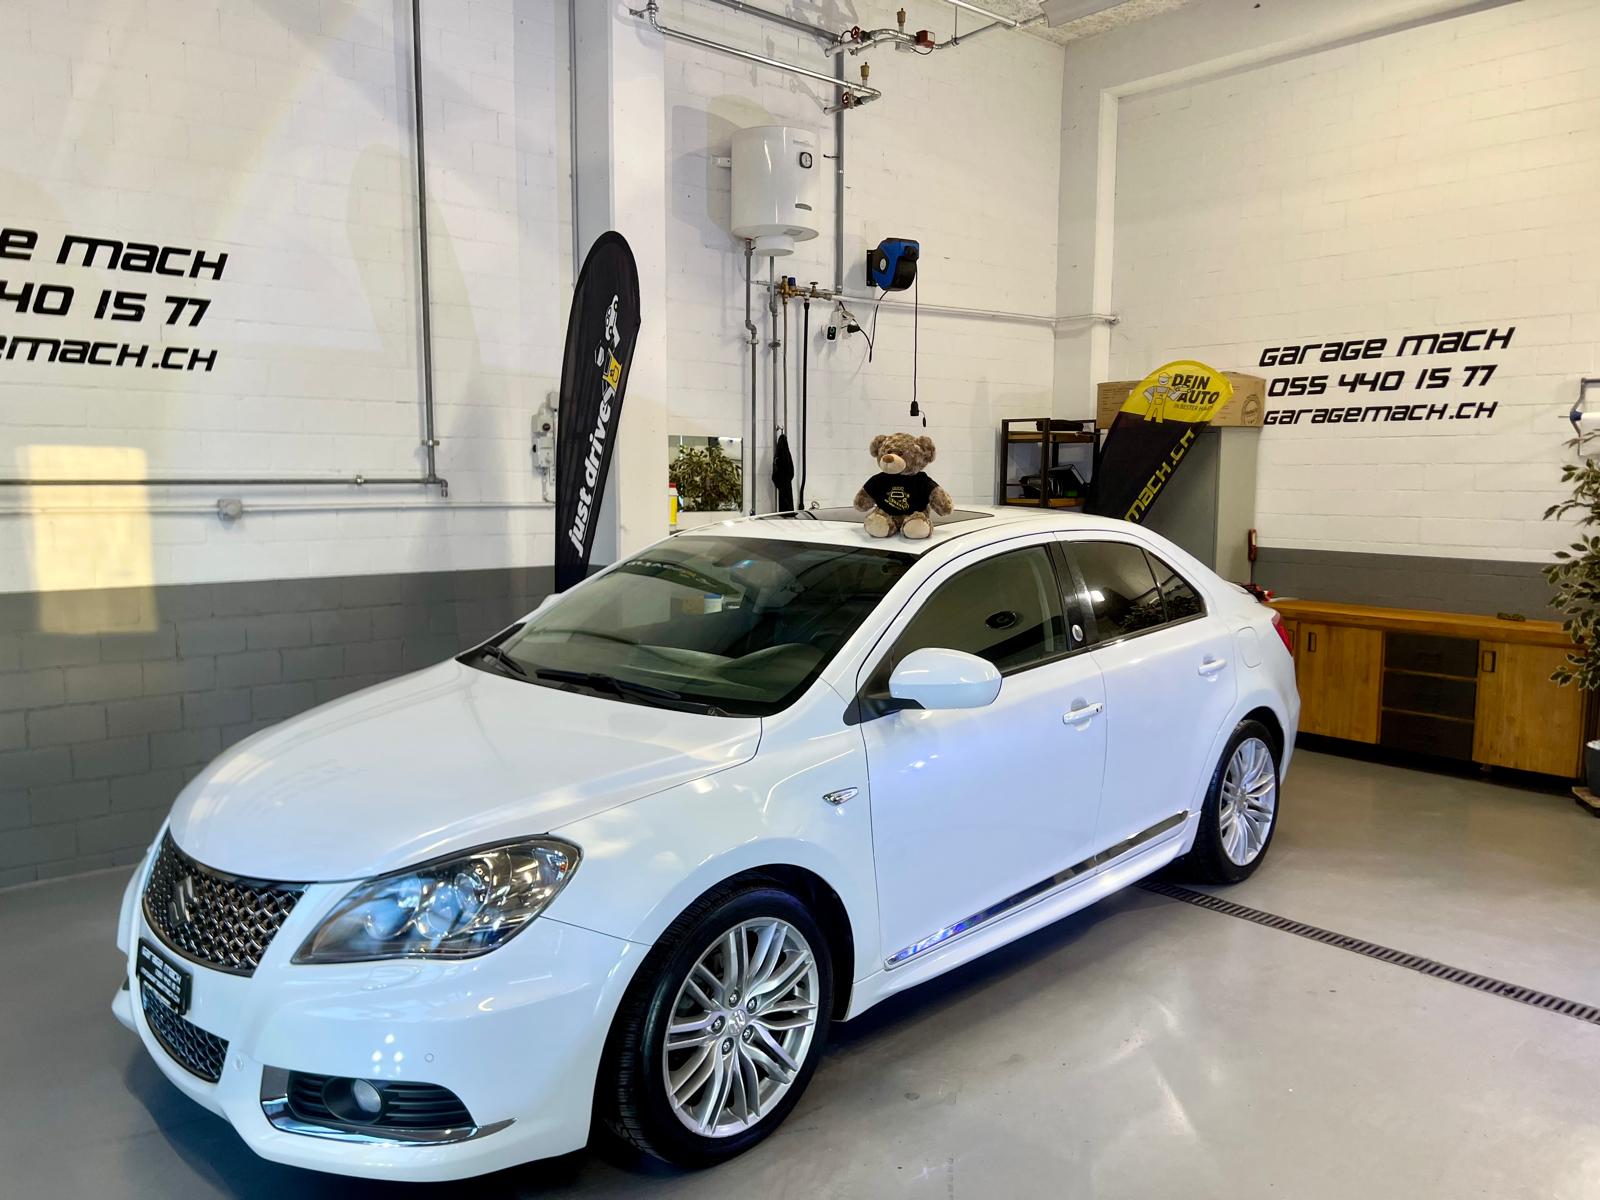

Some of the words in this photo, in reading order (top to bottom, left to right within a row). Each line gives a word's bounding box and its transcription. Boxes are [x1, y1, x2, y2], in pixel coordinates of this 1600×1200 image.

[94, 289, 148, 322] 15
[165, 295, 212, 327] 77
[1171, 373, 1211, 390] DEIN
[1177, 391, 1219, 404] AUTO
[1267, 375, 1329, 398] 055
[1338, 370, 1406, 393] 440
[1415, 367, 1452, 390] 15
[1462, 364, 1498, 387] 77
[568, 486, 592, 559] just
[584, 400, 612, 488] drive
